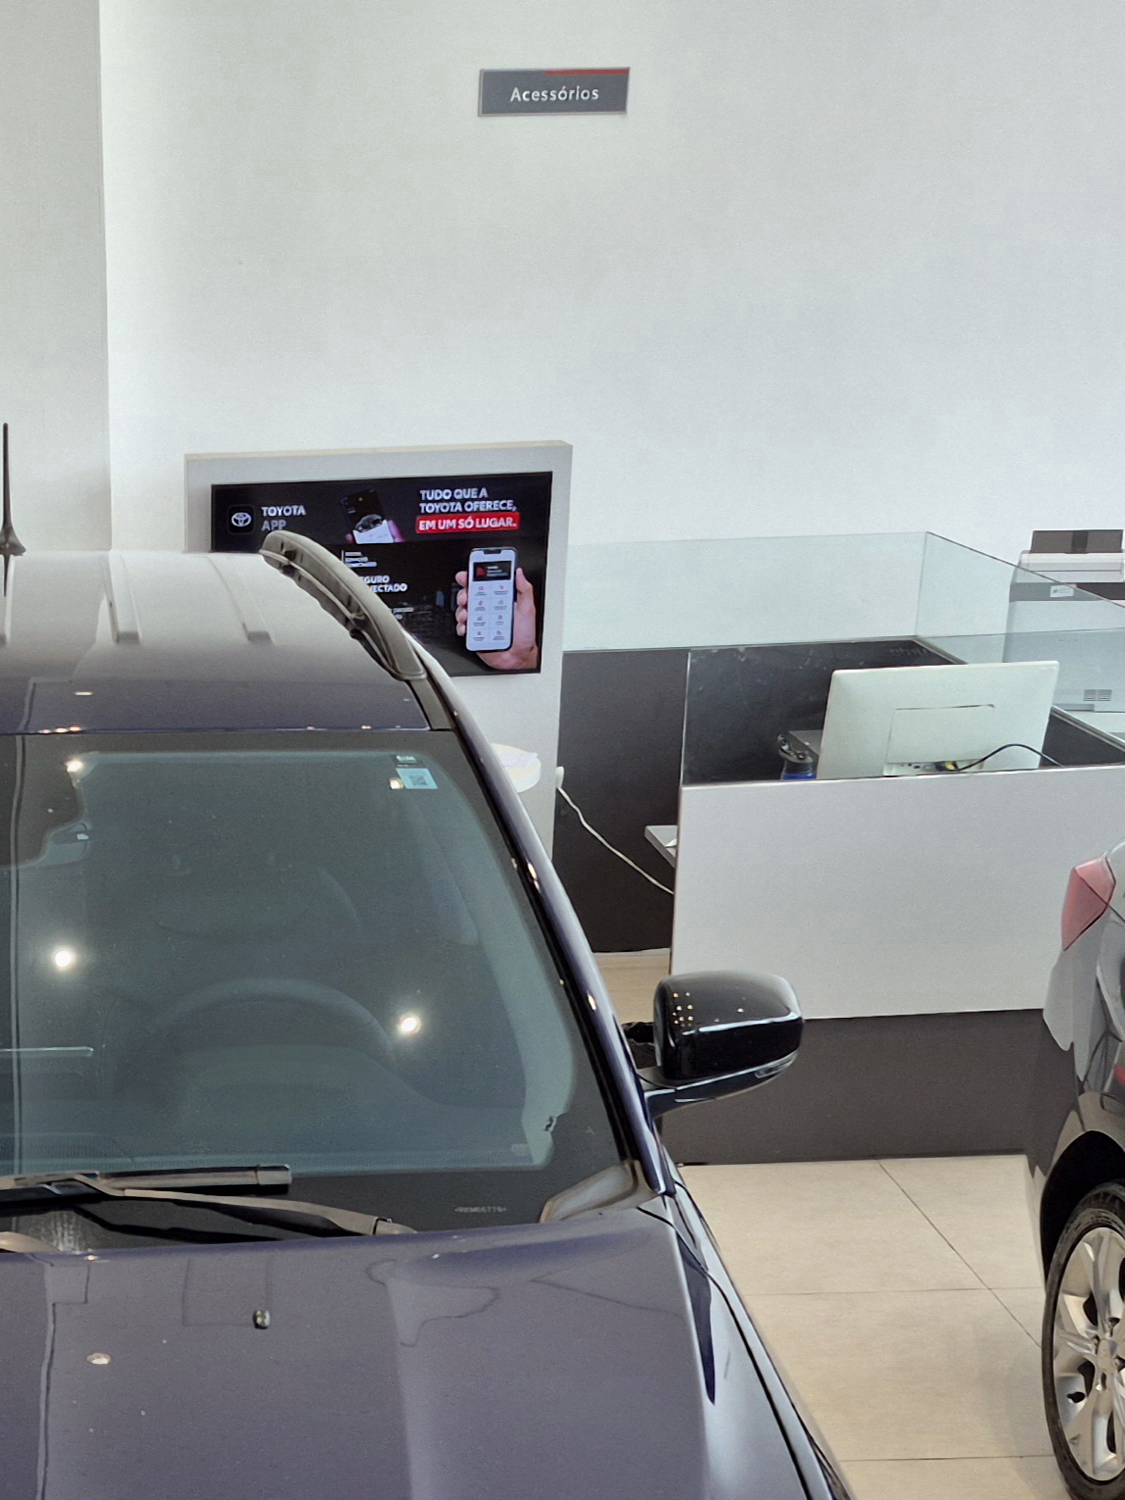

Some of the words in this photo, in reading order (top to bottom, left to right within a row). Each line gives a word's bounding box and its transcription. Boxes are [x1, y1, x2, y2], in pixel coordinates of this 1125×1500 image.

[510, 85, 599, 102] Acessórios
[419, 489, 452, 501] TUDO
[453, 488, 478, 500] QUE
[479, 487, 489, 498] A
[261, 505, 306, 517] TOYOTA
[419, 502, 463, 514] TOYOTA
[464, 499, 517, 512] OFERECE,
[261, 519, 287, 531] APP
[418, 520, 436, 531] EM
[437, 519, 456, 530] UM
[457, 516, 474, 529] SÓ
[475, 517, 517, 529] LUGAR.
[359, 575, 390, 584] GURO
